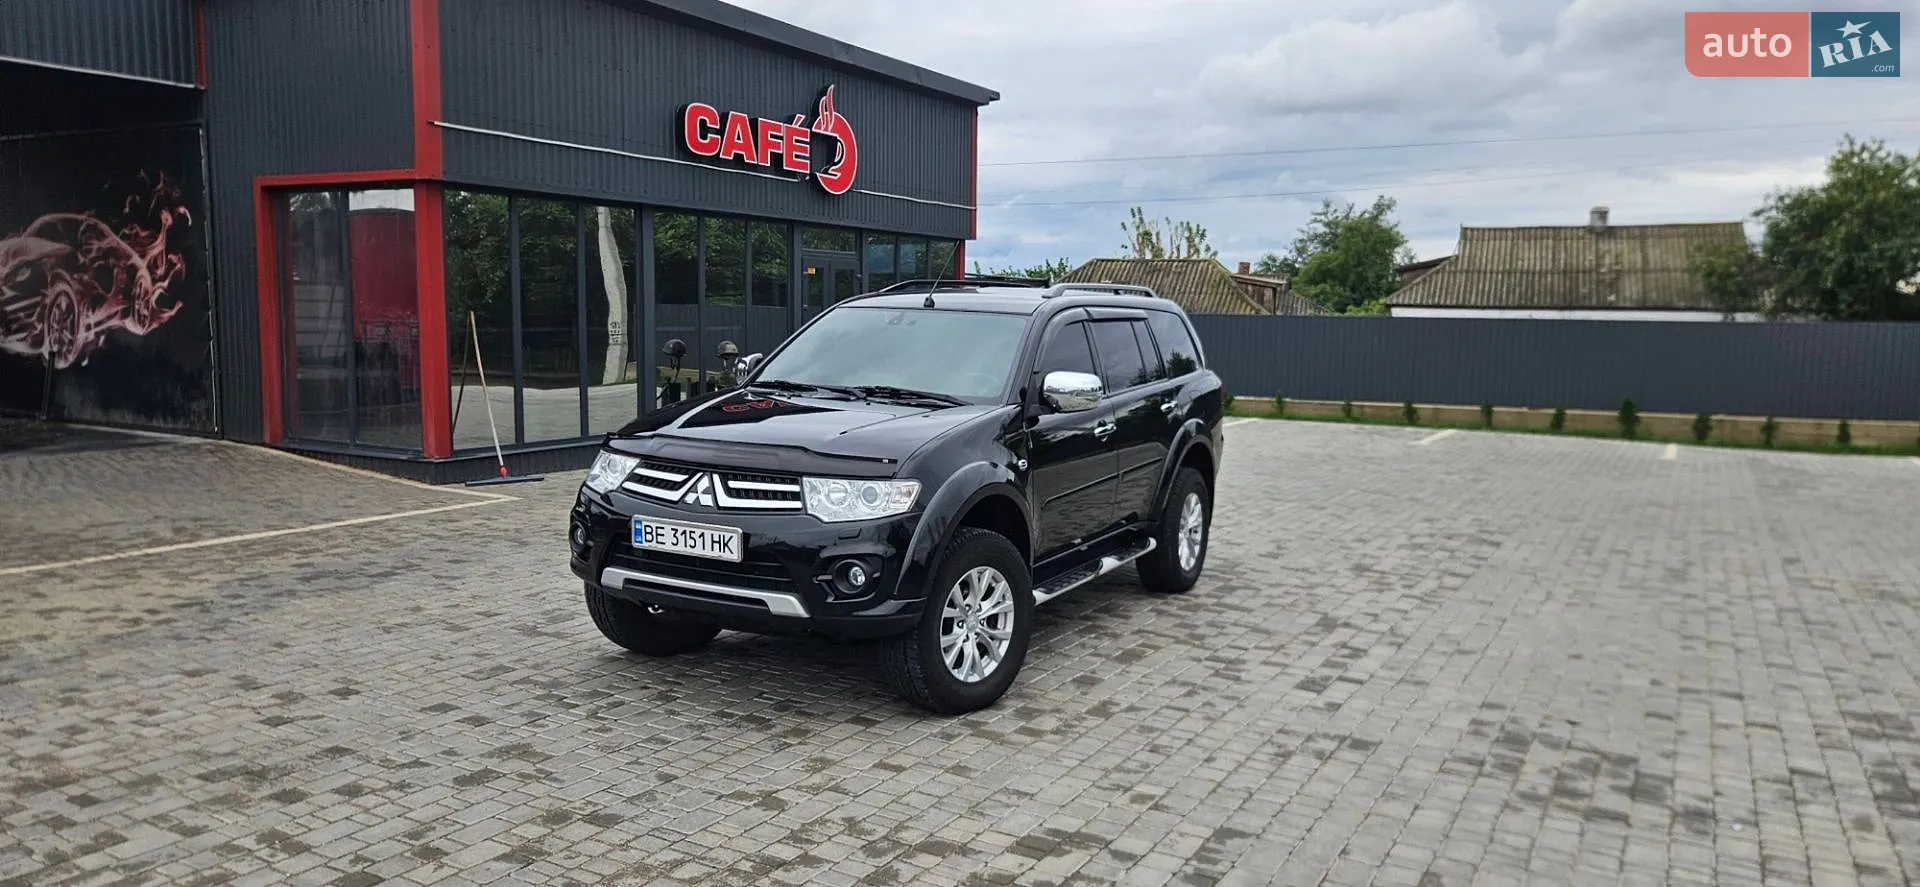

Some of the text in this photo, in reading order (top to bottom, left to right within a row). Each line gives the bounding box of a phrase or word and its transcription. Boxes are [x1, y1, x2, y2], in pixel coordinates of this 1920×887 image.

[684, 102, 811, 174] CAFÉ
[643, 524, 666, 545] BE
[670, 528, 706, 551] 3151
[710, 533, 734, 555] HK
